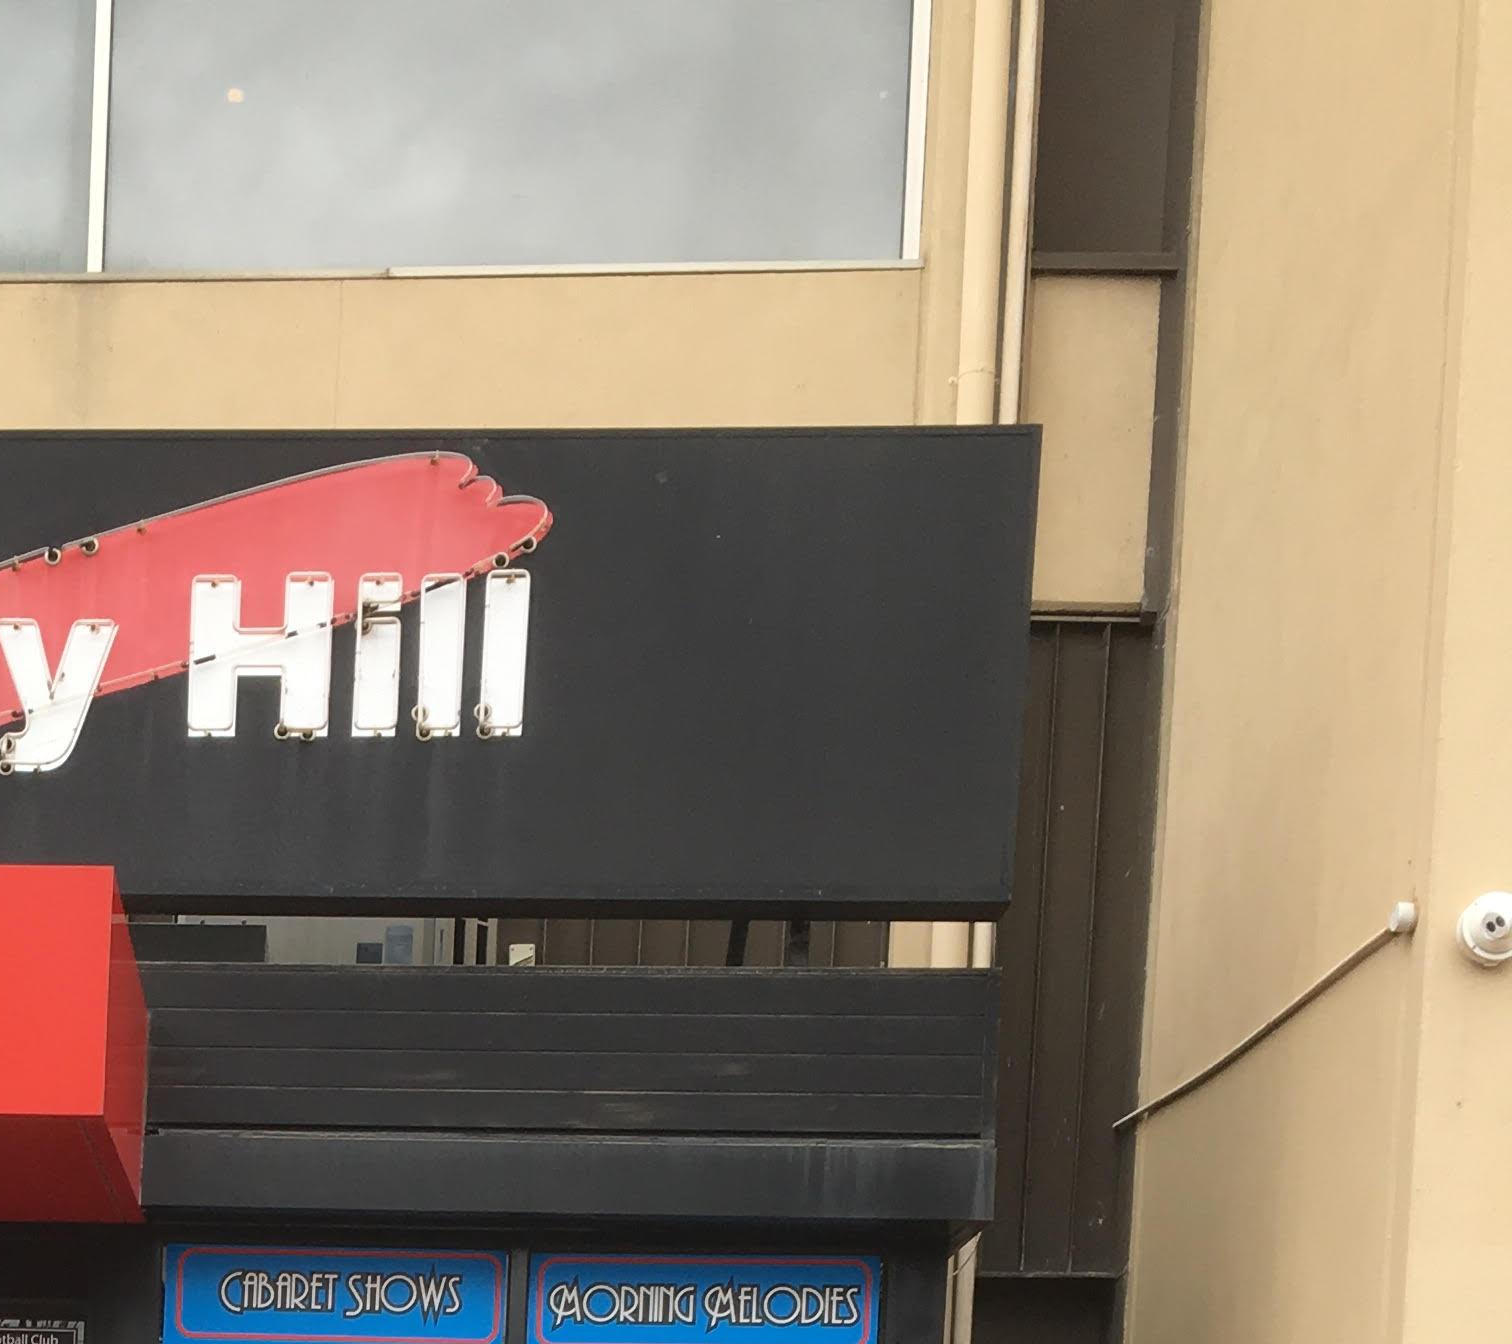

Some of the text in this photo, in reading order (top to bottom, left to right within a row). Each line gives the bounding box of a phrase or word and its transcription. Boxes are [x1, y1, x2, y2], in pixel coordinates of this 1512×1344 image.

[188, 568, 531, 740] Hill
[219, 1264, 463, 1327] CABARET SHOWS
[548, 1275, 861, 1333] MORNING MELODIES
